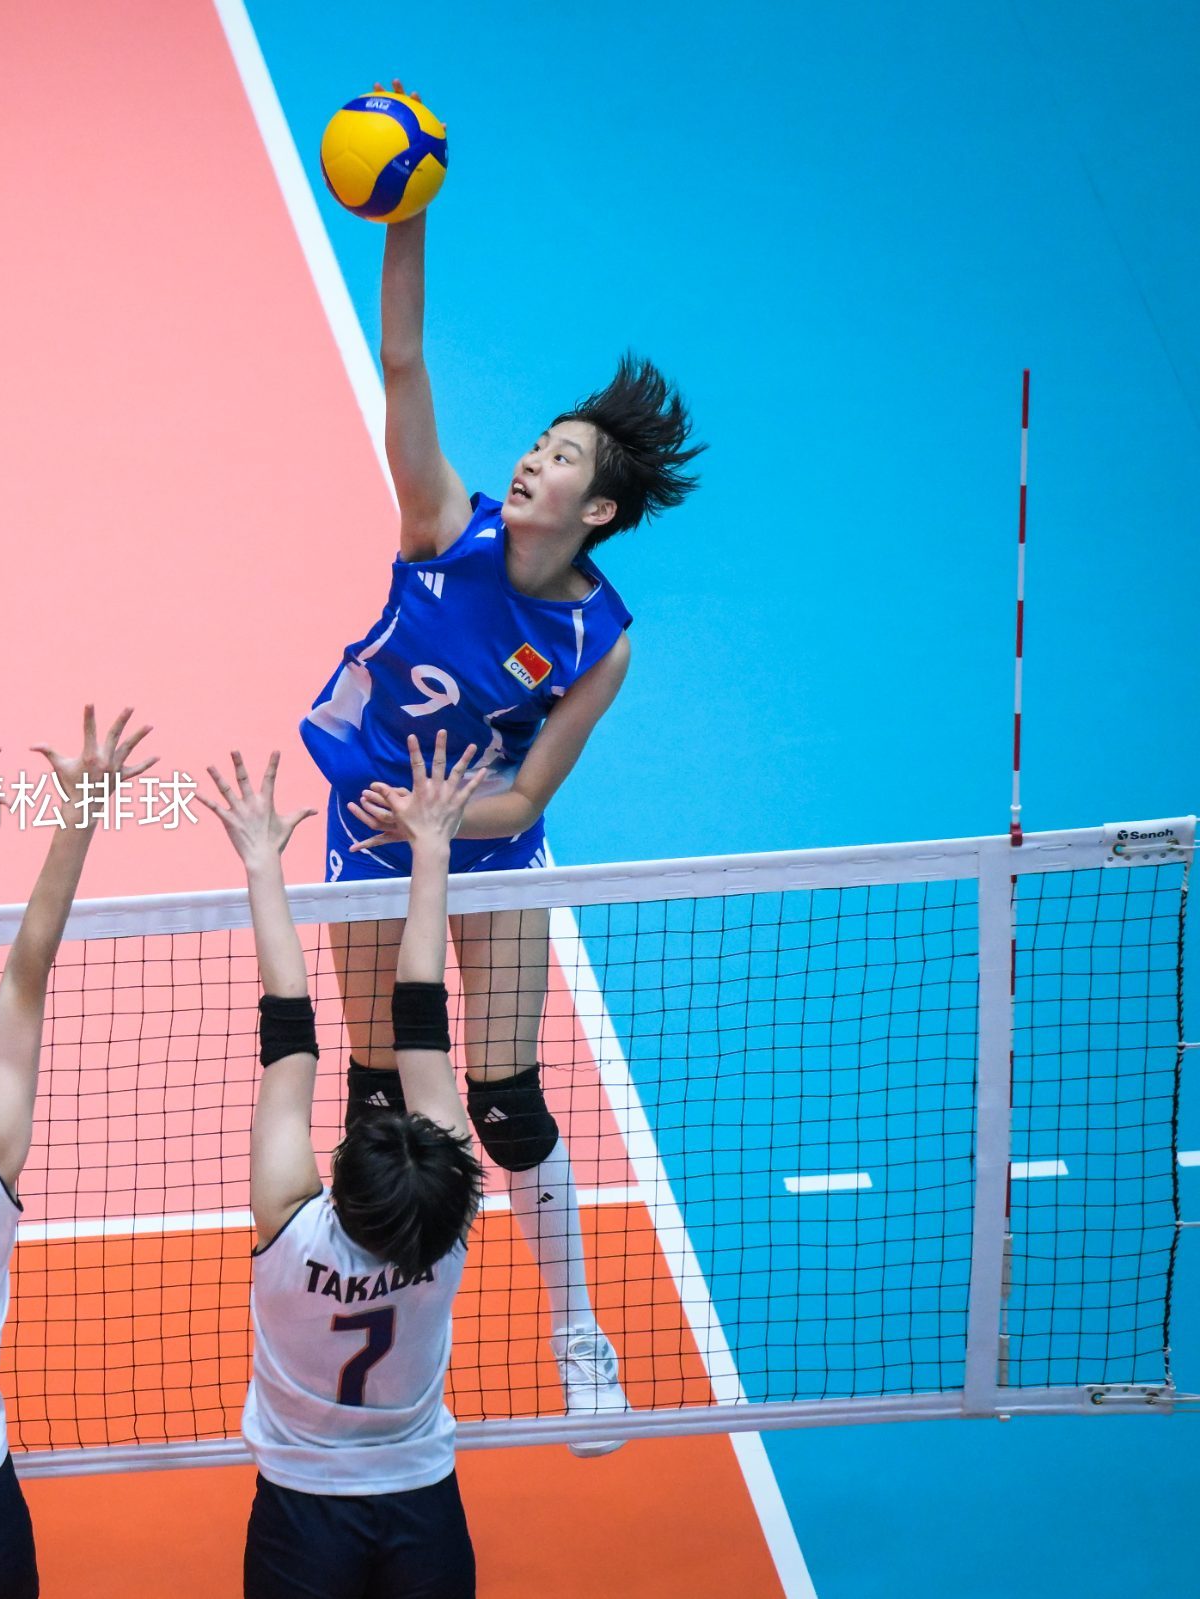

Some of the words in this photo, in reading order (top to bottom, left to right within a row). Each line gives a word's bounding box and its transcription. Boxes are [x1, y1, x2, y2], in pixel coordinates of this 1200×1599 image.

[510, 661, 533, 685] CHN
[400, 664, 460, 717] 9
[1130, 829, 1175, 841] Senoh
[329, 849, 343, 882] 9
[330, 1304, 397, 1406] 7
